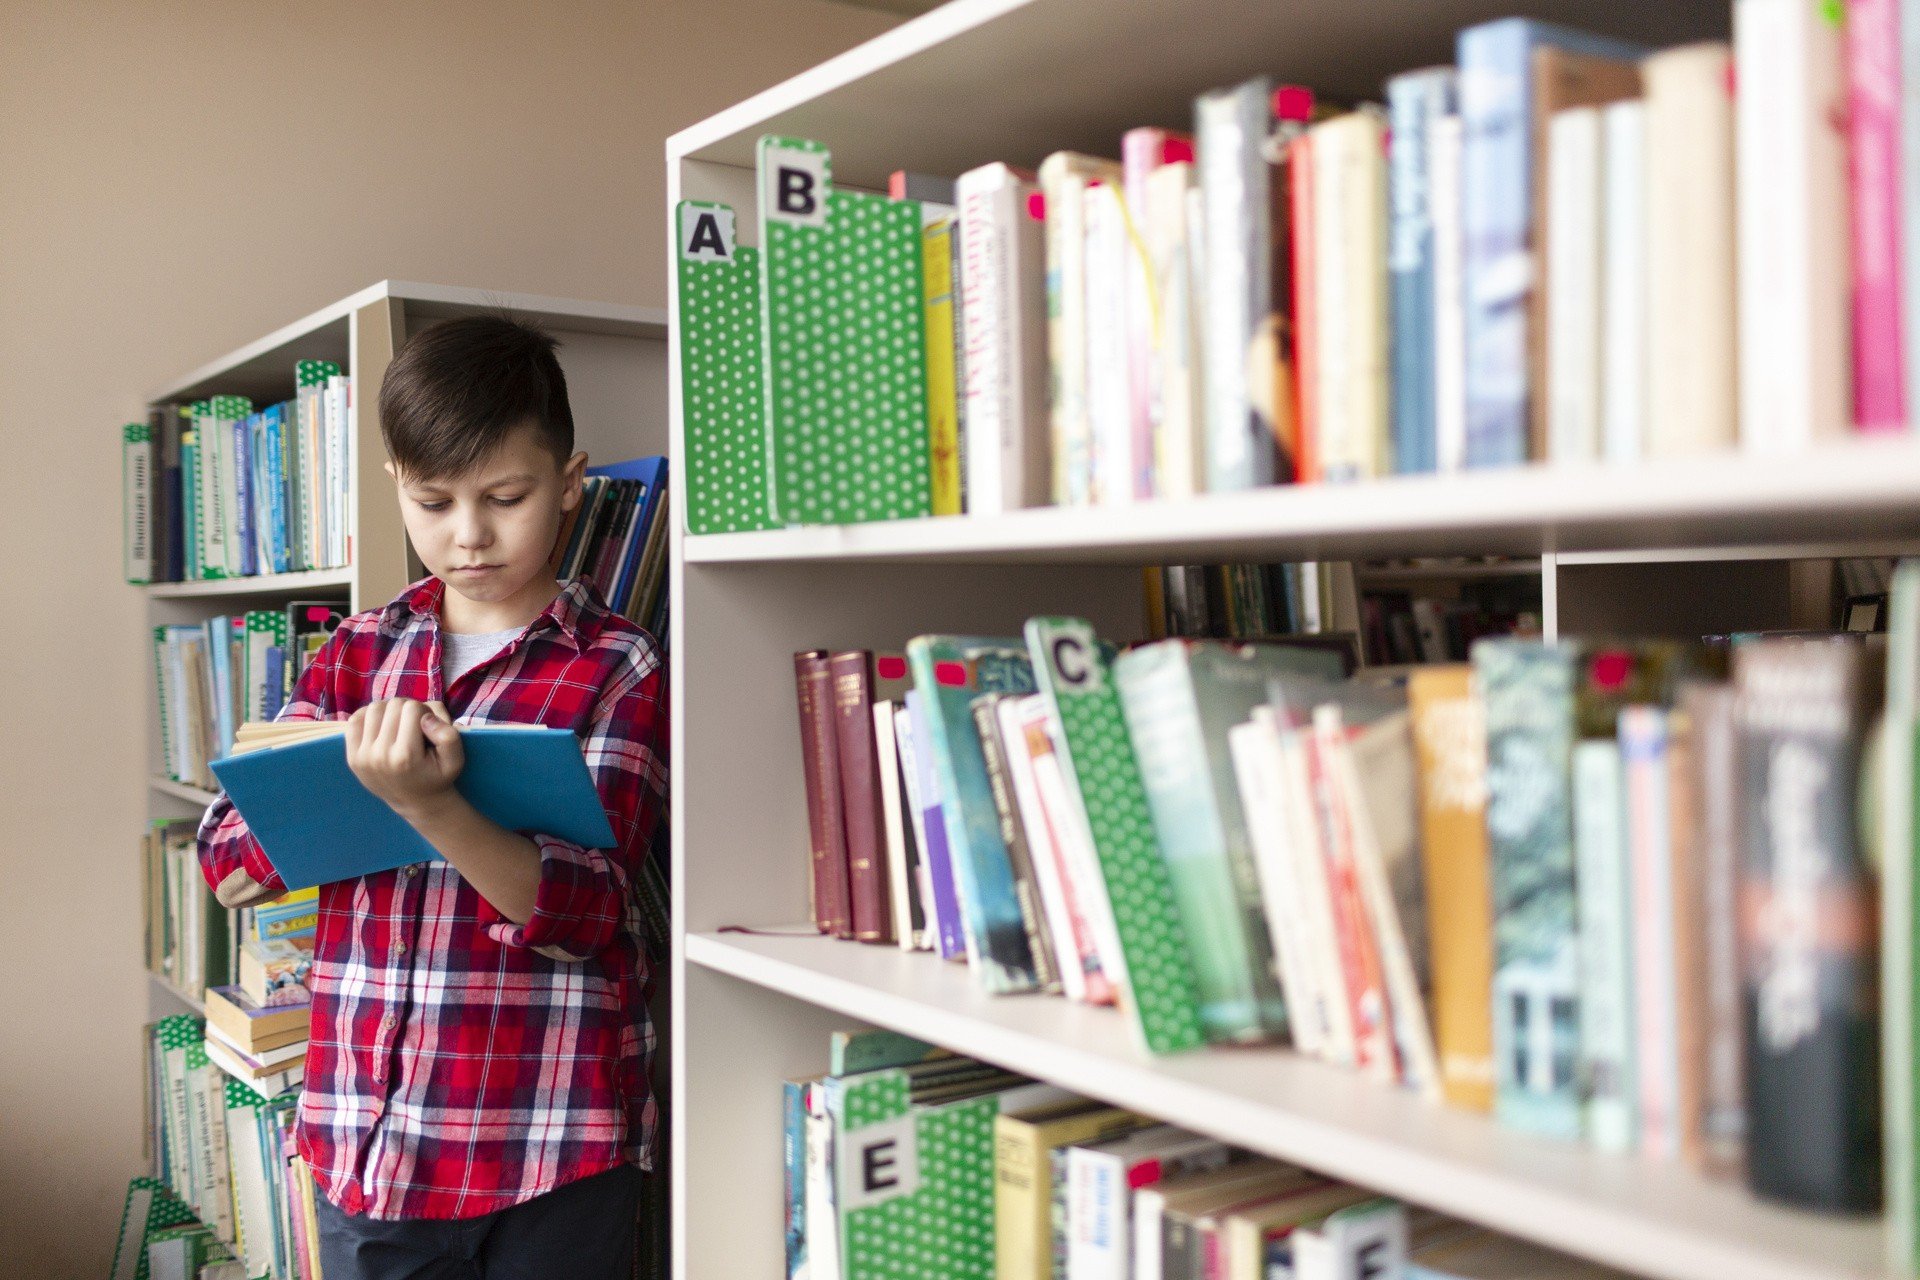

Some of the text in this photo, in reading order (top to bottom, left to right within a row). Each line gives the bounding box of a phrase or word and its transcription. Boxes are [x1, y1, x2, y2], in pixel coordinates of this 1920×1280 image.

[777, 166, 816, 217] B
[688, 213, 728, 256] A
[1052, 637, 1088, 685] C
[863, 1139, 900, 1193] E
